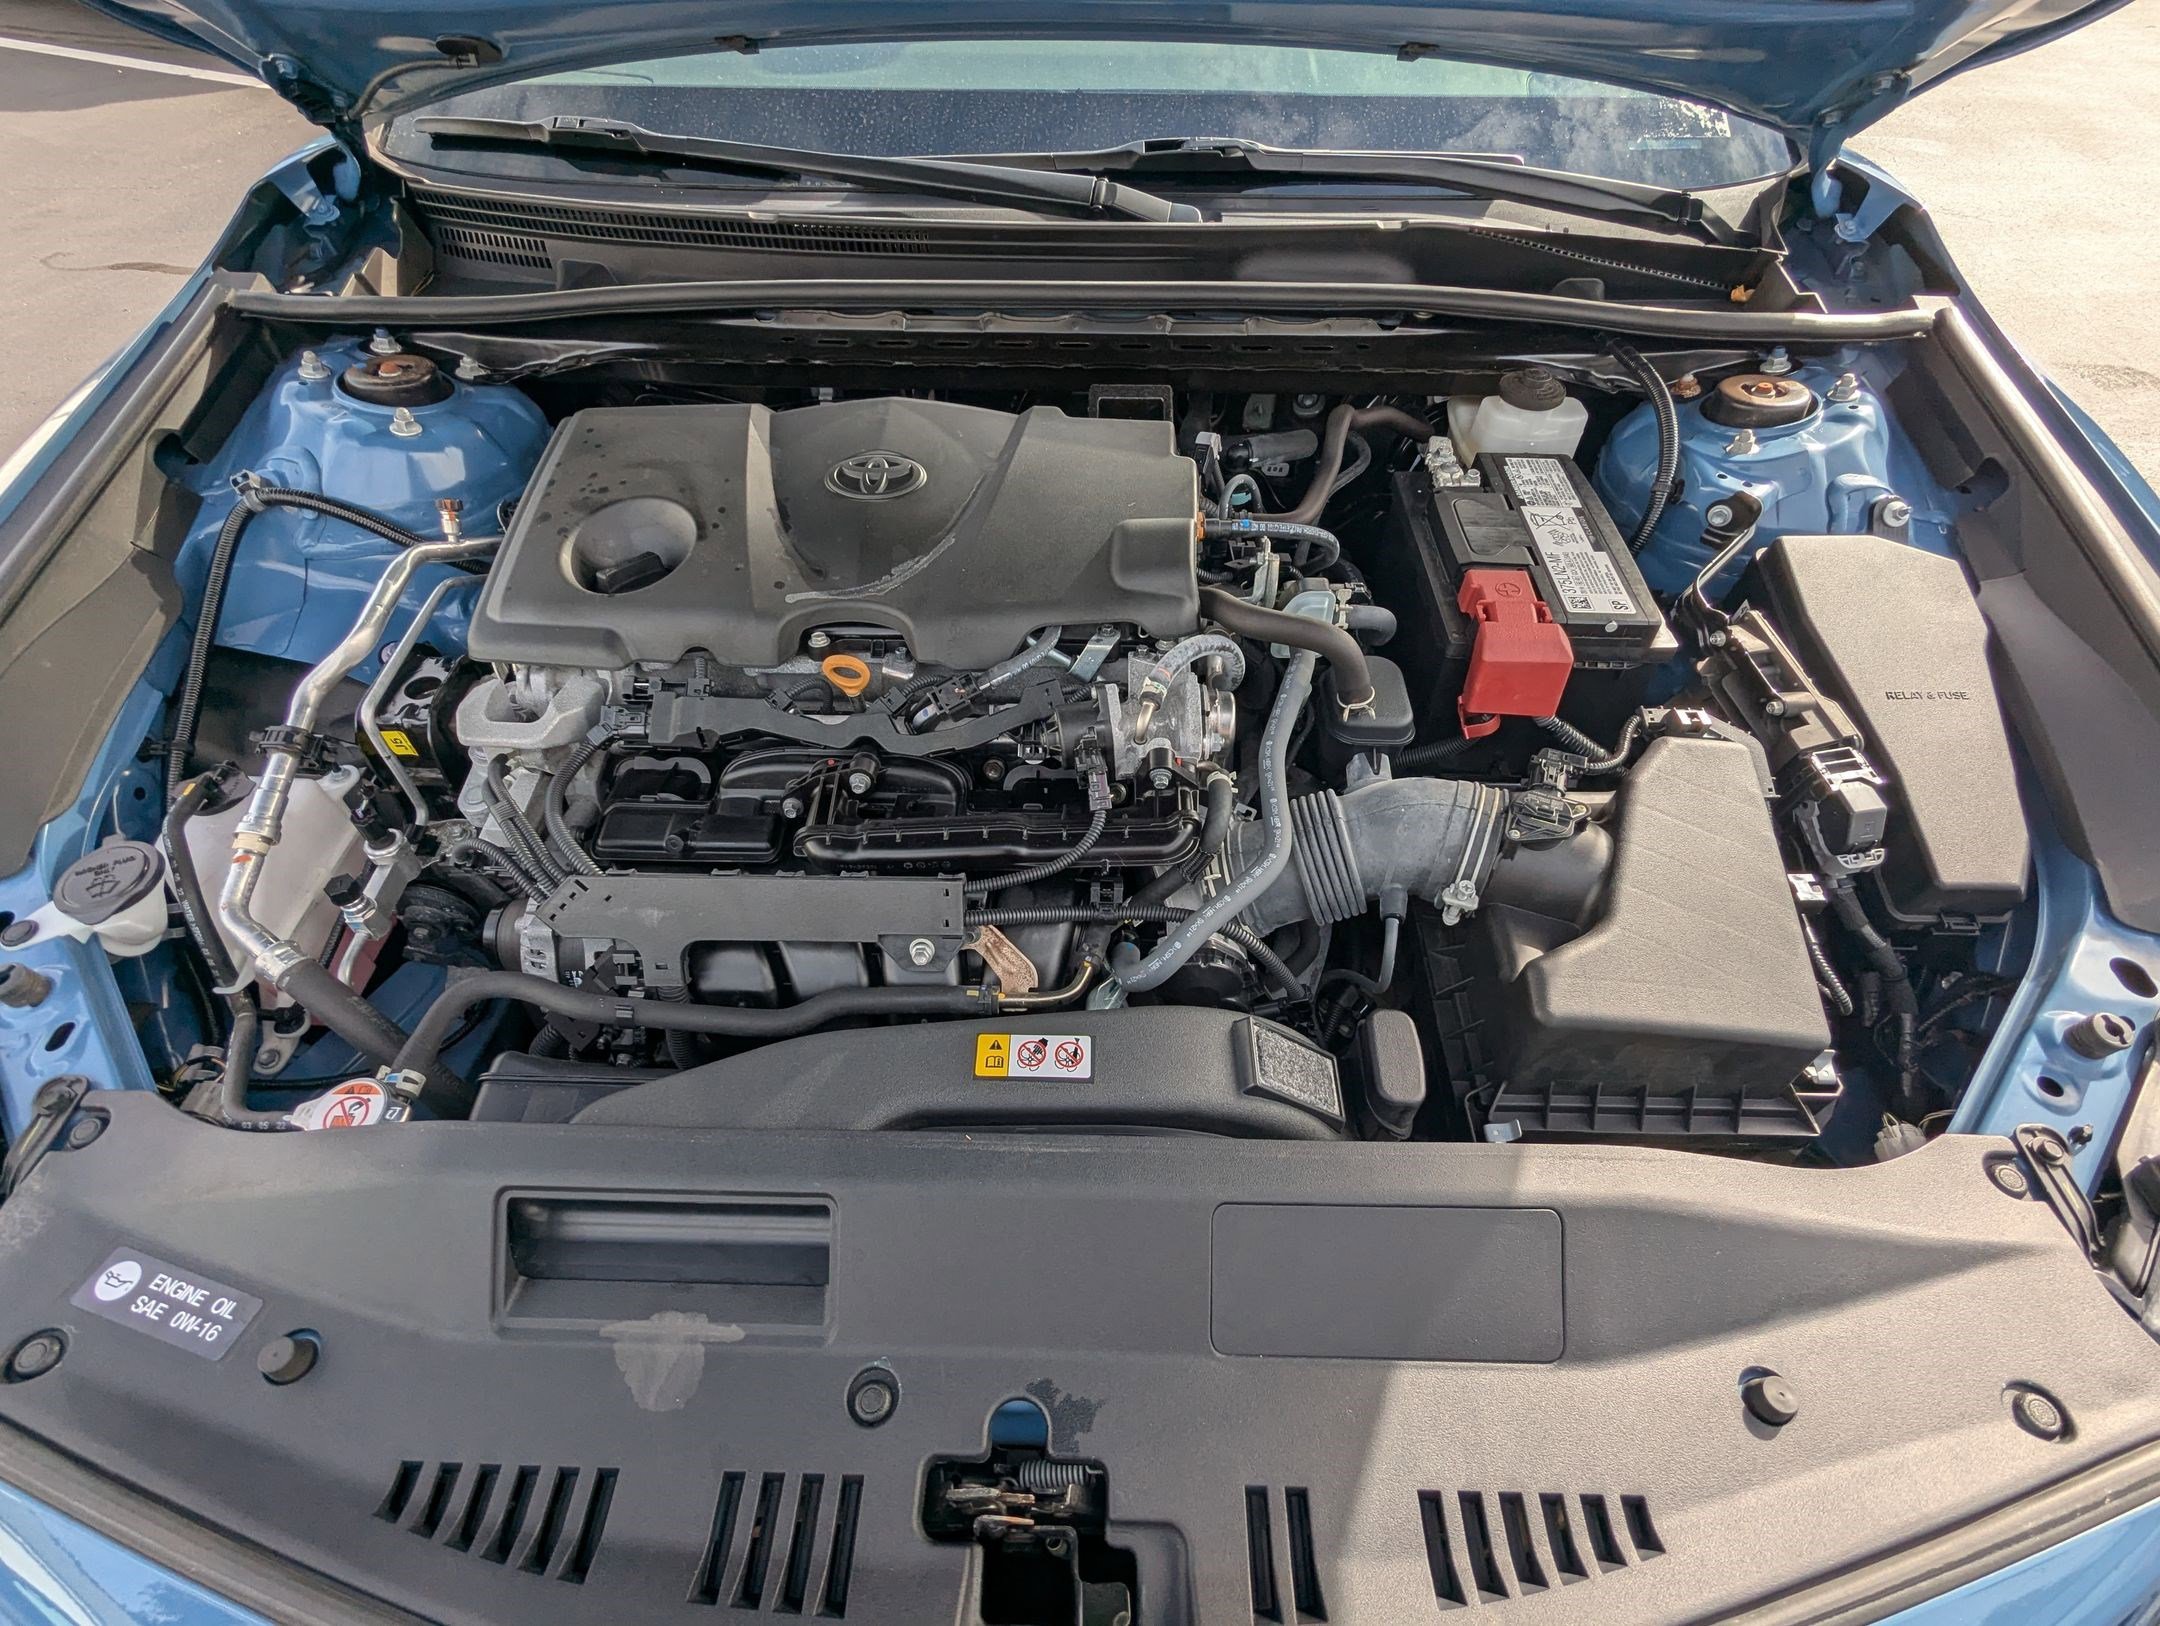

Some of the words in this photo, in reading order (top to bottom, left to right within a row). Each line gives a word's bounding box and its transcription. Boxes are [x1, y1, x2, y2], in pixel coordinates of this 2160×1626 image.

[1545, 552, 1577, 594] 375LN2-MF
[1613, 600, 1629, 611] SP
[1885, 691, 1923, 700] RELAY
[1926, 691, 1936, 700] &
[1937, 691, 1970, 700] FUSE
[148, 1273, 210, 1308] ENGINE
[211, 1297, 237, 1320] OIL
[131, 1295, 169, 1321] SAE
[169, 1311, 223, 1342] 0W-16
